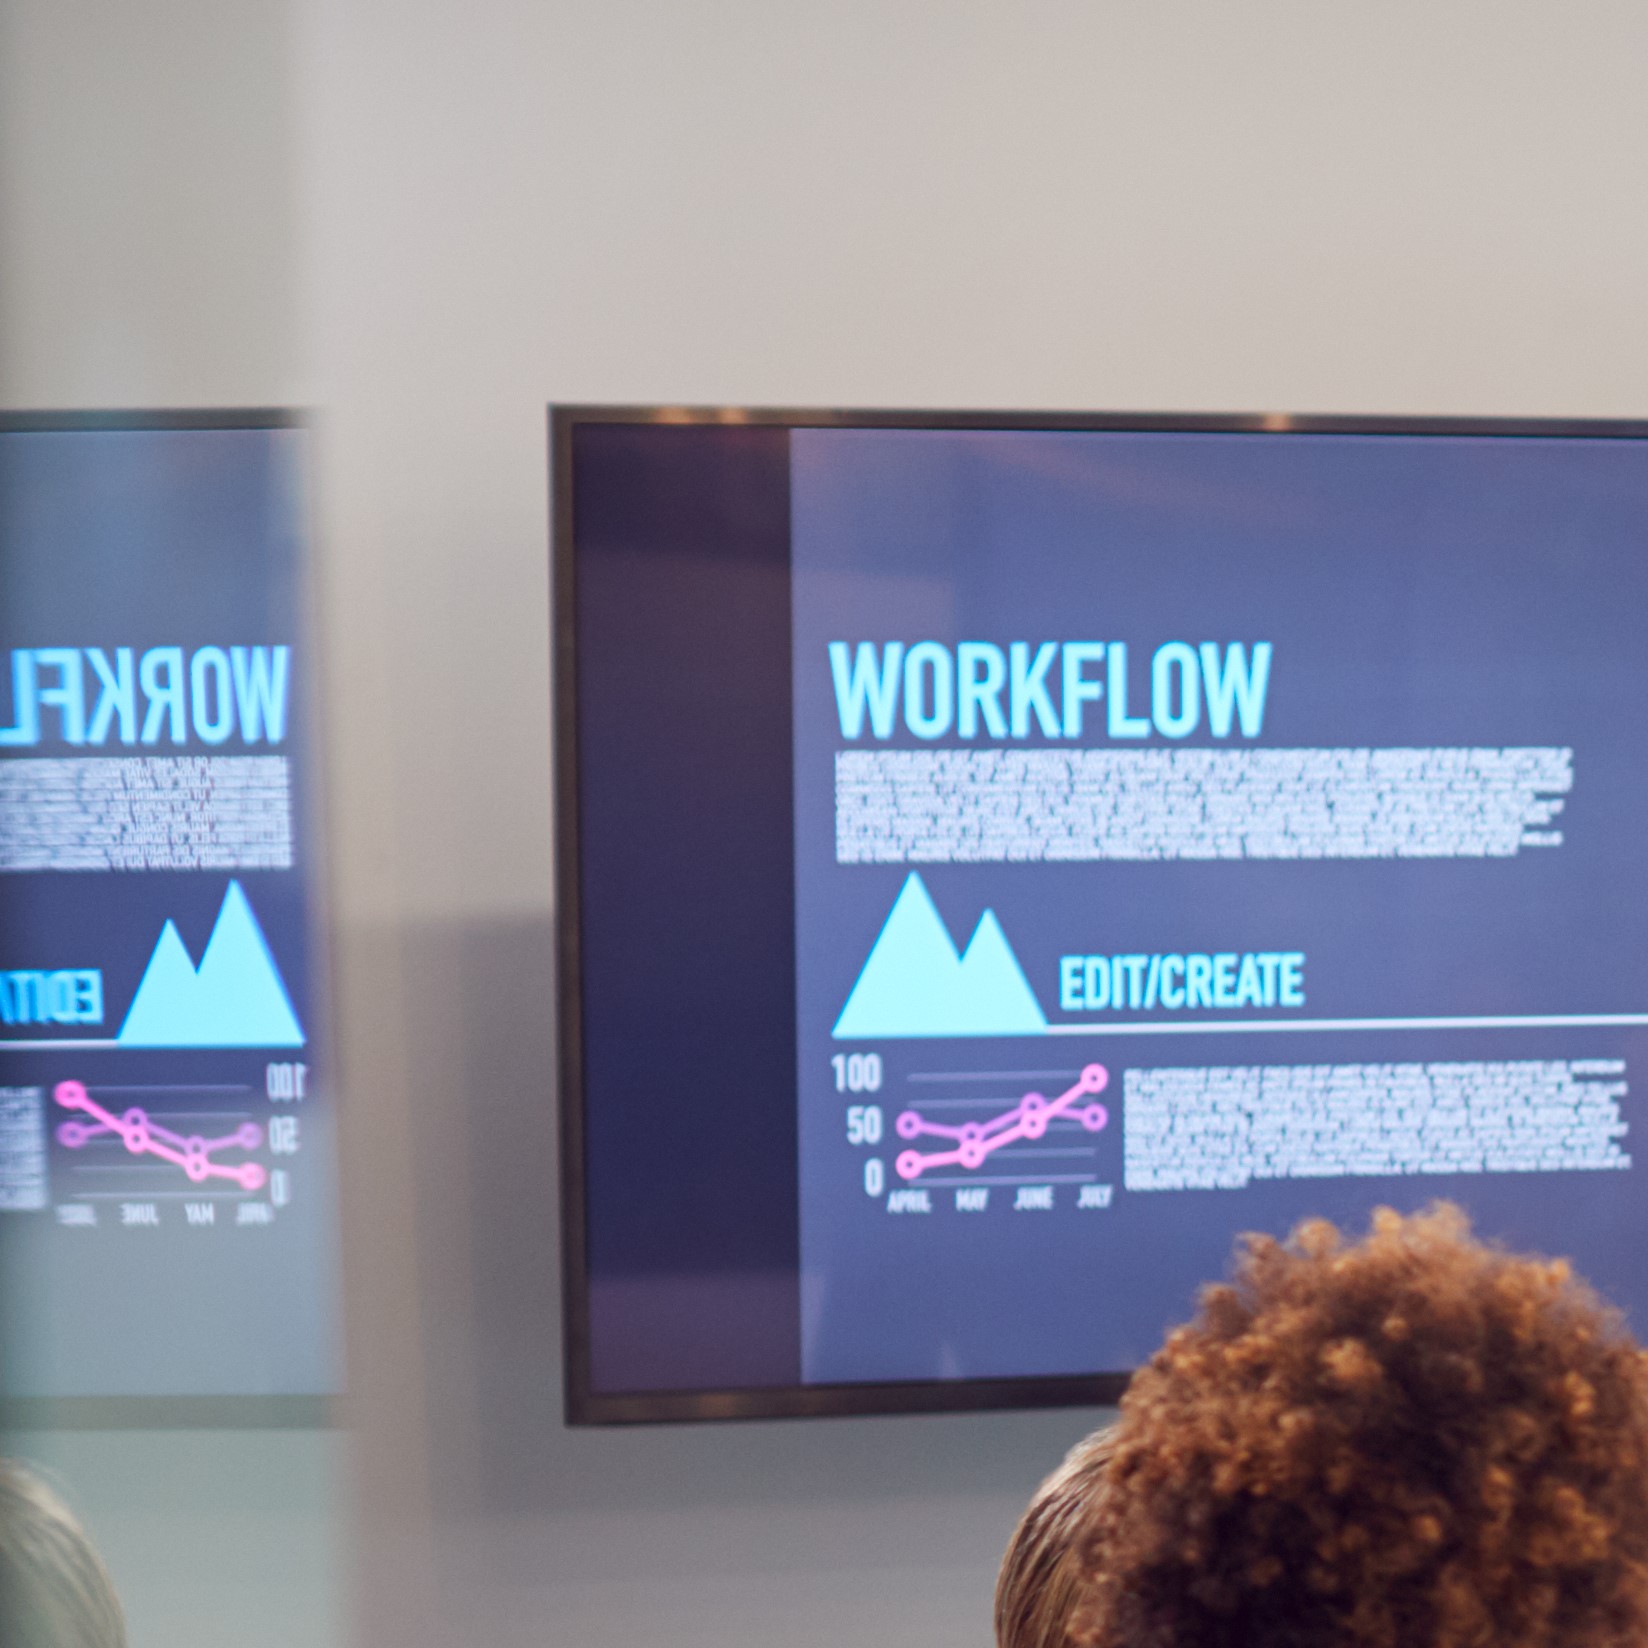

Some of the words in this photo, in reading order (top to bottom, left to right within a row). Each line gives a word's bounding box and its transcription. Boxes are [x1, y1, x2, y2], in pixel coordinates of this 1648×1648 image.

[827, 640, 1273, 740] WORKFLOW
[1059, 951, 1305, 1011] EDIT/CREATE
[830, 1052, 883, 1093] 100
[846, 1105, 883, 1145] 50
[864, 1158, 885, 1199] 0
[1012, 1185, 1055, 1212] JUNE
[1076, 1183, 1114, 1210] JULY
[886, 1188, 933, 1214] APRIL
[955, 1187, 989, 1213] MAY
